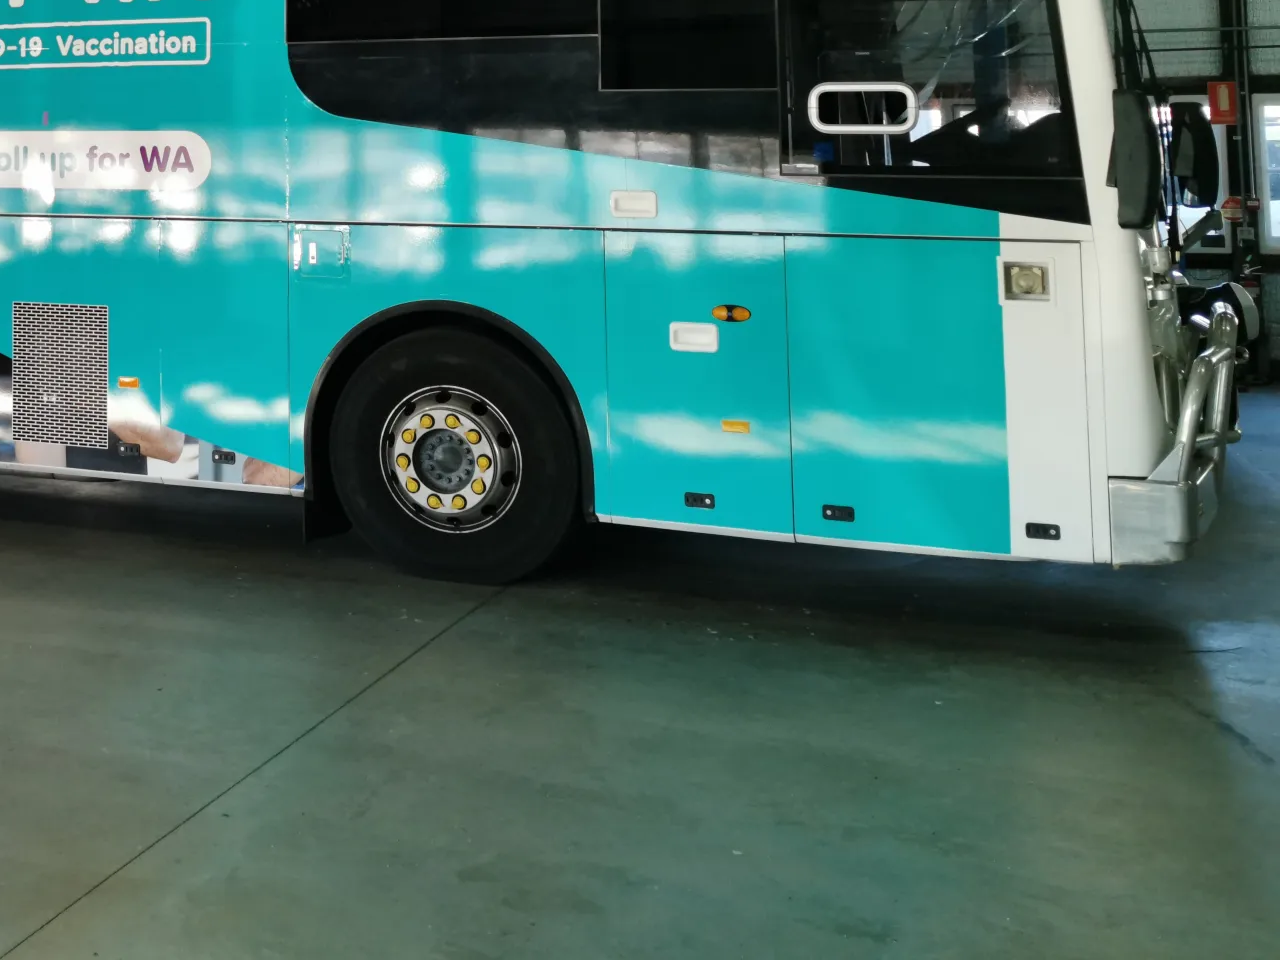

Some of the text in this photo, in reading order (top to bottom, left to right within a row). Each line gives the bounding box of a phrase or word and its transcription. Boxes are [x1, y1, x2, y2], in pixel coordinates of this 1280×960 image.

[56, 30, 196, 56] Vaccination
[39, 152, 78, 179] up
[86, 145, 130, 172] for
[139, 145, 195, 173] WA
